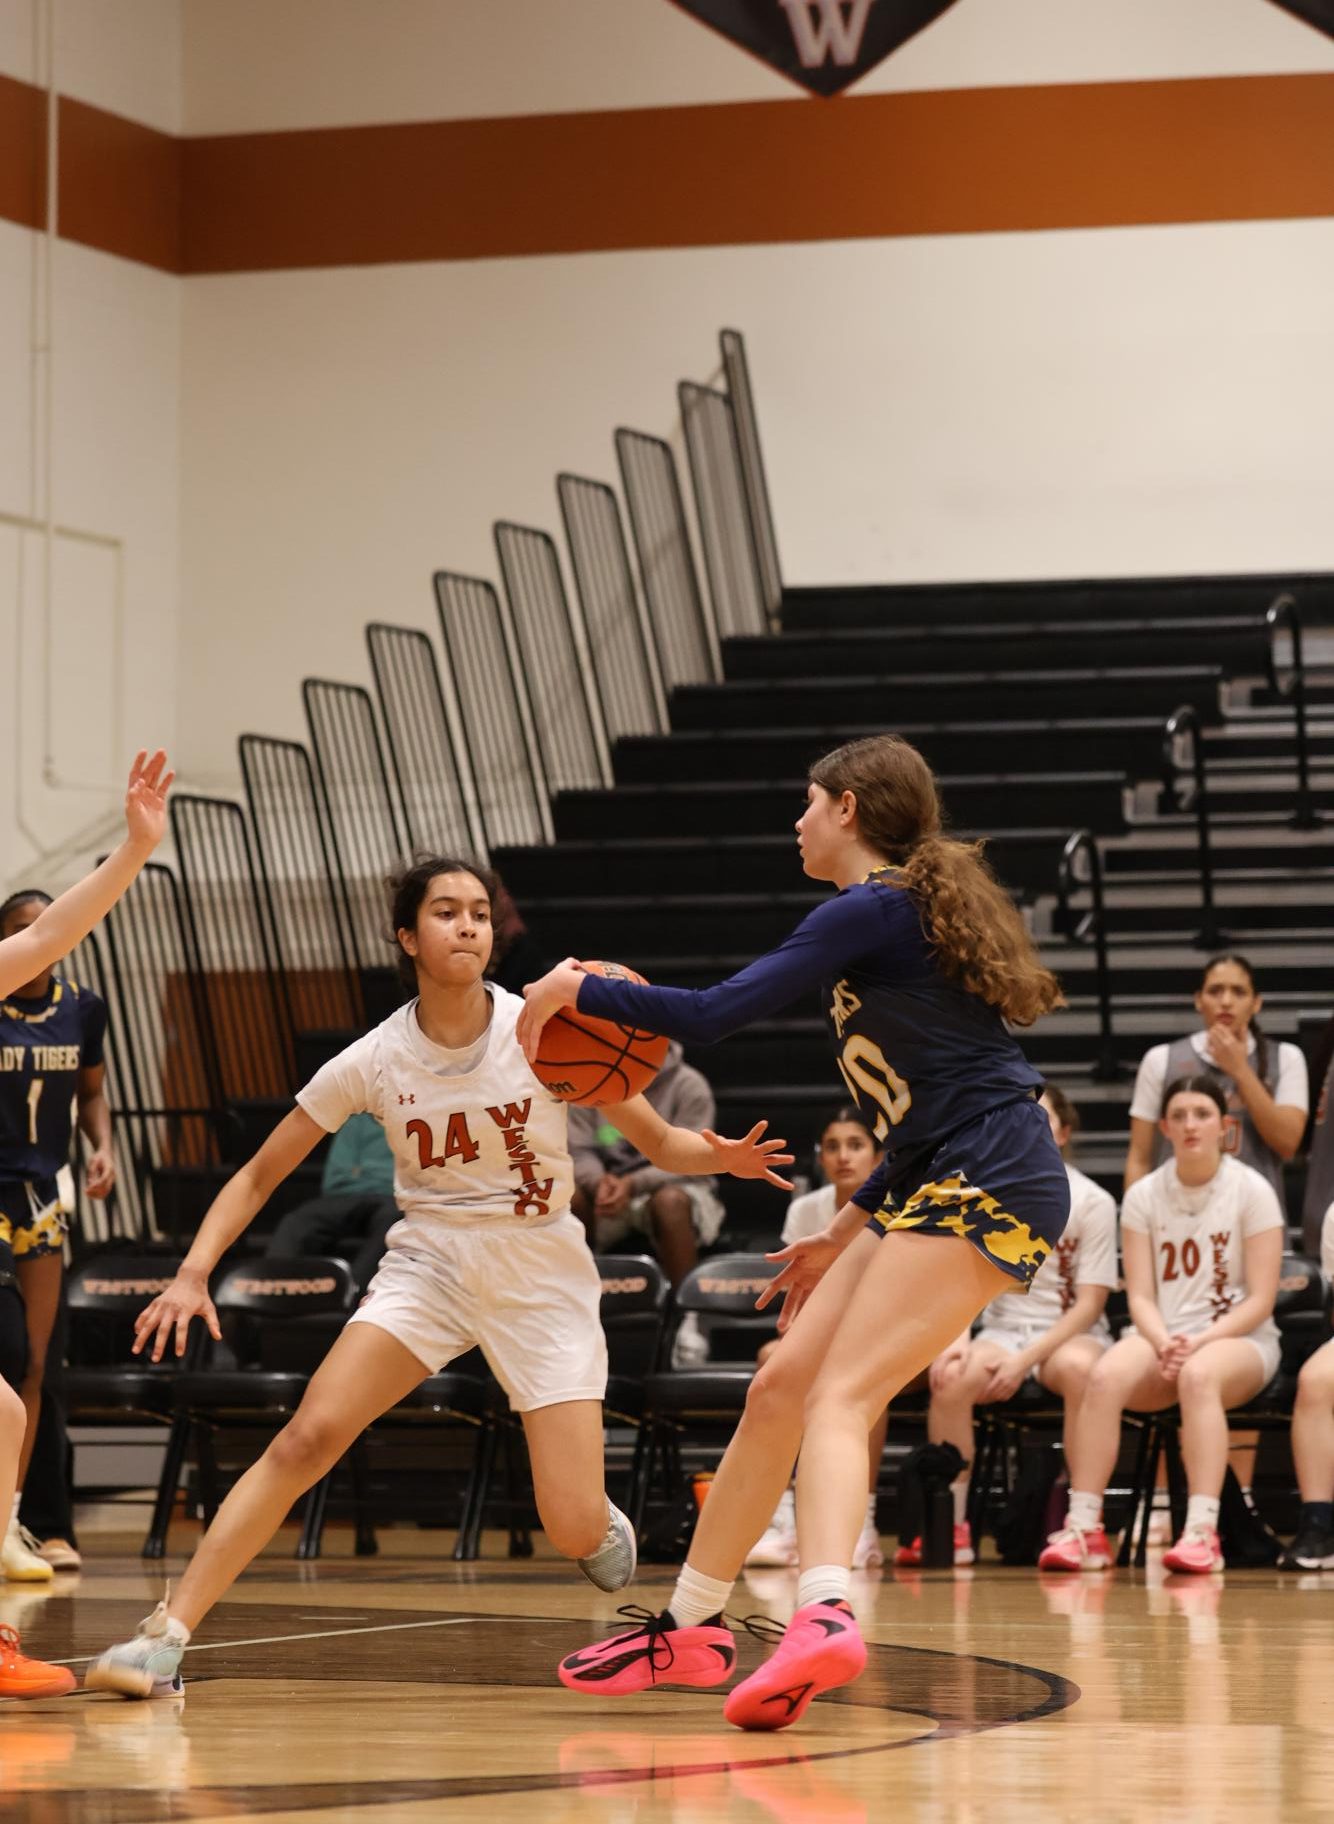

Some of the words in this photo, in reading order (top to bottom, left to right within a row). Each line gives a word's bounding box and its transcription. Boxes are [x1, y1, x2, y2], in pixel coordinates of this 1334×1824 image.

[778, 0, 874, 67] W
[0, 1046, 25, 1071] DY
[32, 1045, 80, 1071] TIGERS
[27, 1079, 44, 1144] 1
[406, 1111, 480, 1170] 24
[1161, 1238, 1200, 1281] 20
